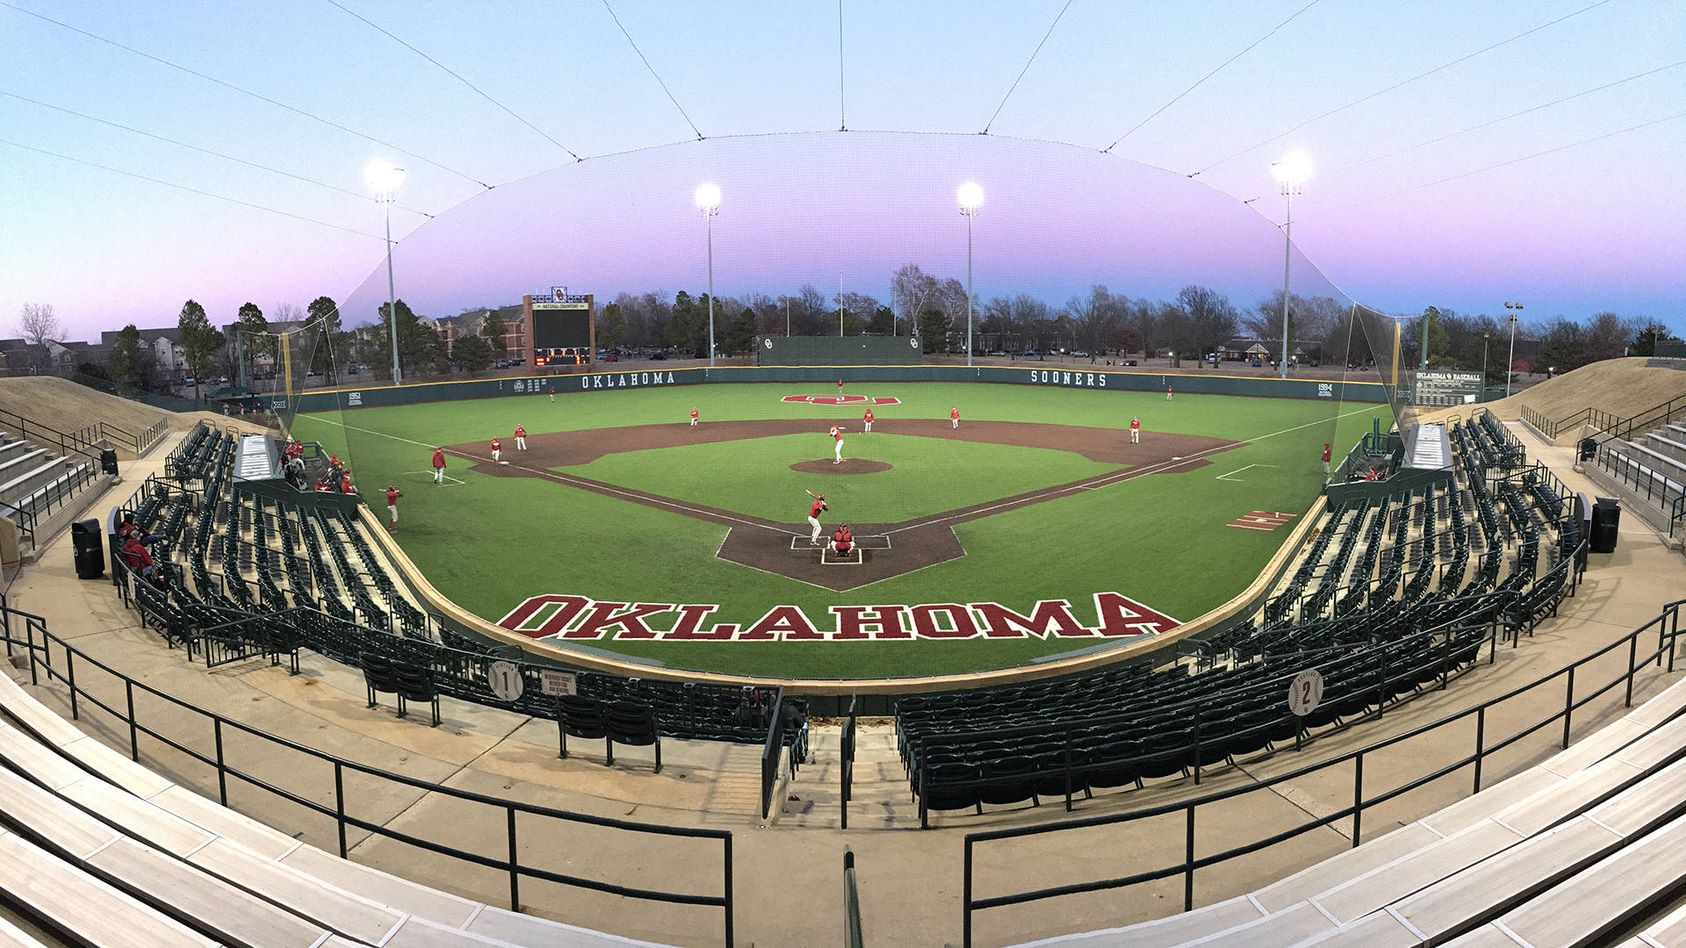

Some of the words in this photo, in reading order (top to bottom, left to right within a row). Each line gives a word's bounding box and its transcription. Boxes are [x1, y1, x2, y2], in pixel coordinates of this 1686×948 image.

[582, 372, 675, 388] OKLAHOMA
[1031, 370, 1106, 386] SOONERS
[1416, 372, 1446, 380] OKLAHOMA
[496, 592, 1184, 641] OKLAHOMA
[502, 671, 508, 691] 1
[1303, 681, 1310, 704] 2
